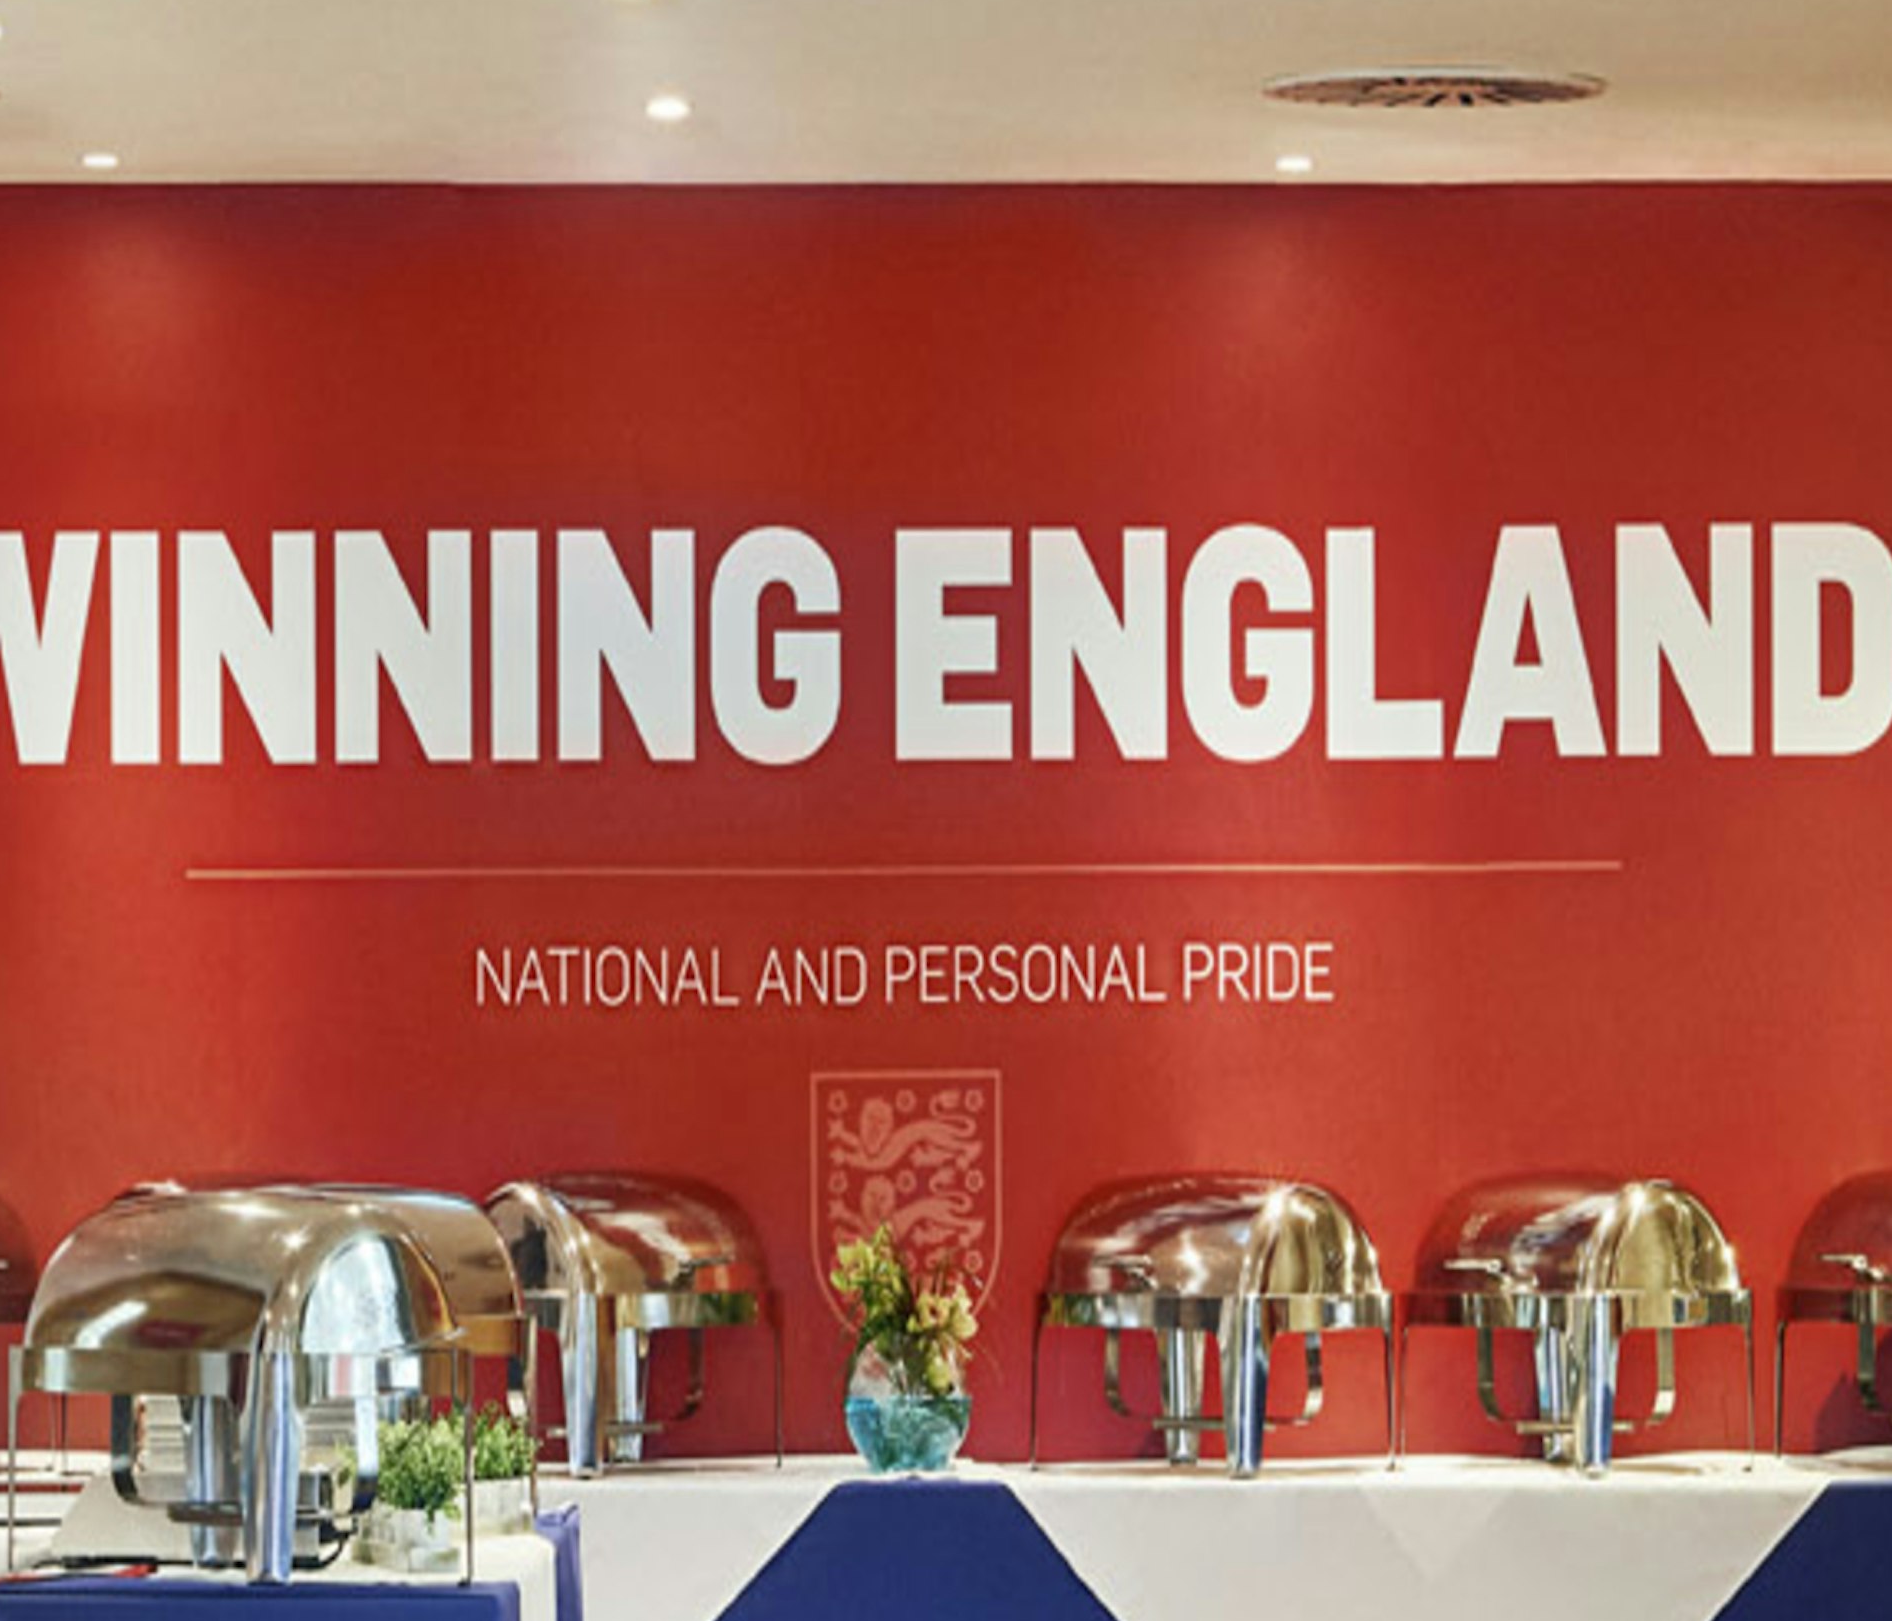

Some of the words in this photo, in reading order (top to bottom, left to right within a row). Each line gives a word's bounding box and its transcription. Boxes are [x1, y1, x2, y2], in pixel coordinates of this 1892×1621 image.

[477, 945, 740, 1007] NATIONAL
[756, 945, 868, 1006] AND
[886, 942, 1169, 1005] PERSONAL
[1182, 940, 1336, 1005] PRIDE
